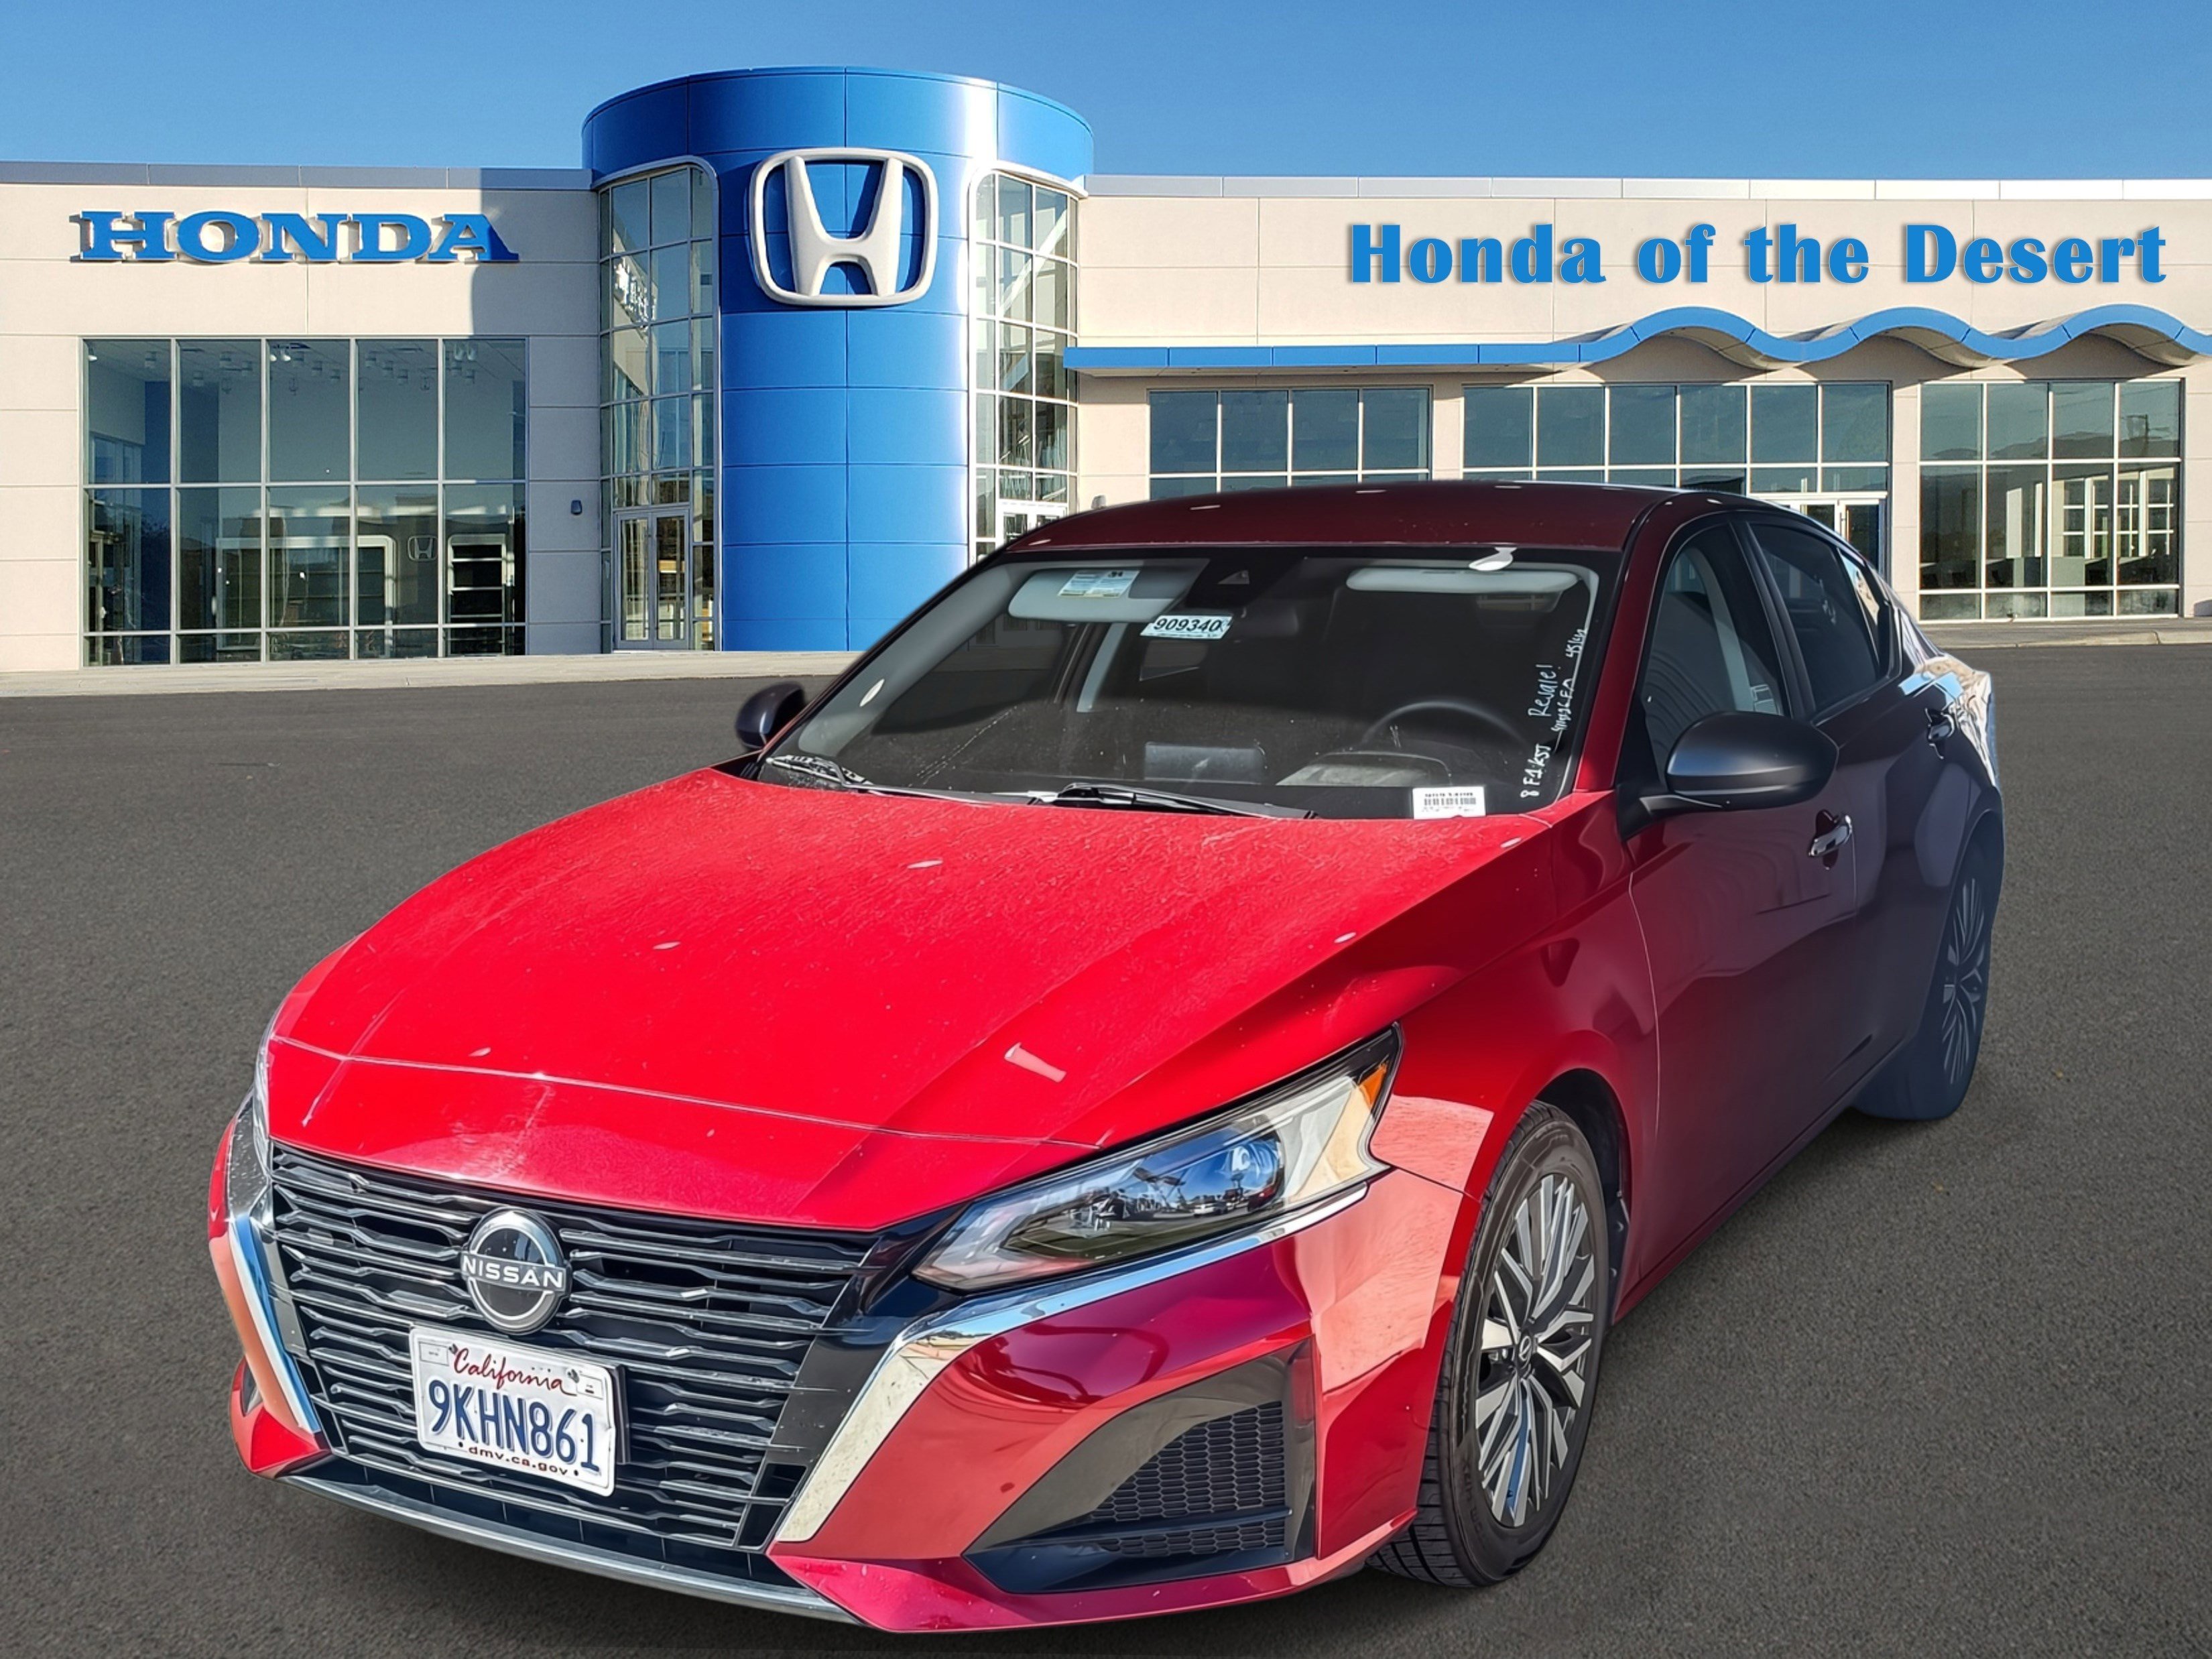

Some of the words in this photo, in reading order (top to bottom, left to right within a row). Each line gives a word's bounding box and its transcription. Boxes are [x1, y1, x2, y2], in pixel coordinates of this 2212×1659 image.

[78, 210, 519, 262] HONDA
[1351, 223, 1607, 284] Honda
[1638, 223, 1717, 284] of
[1743, 223, 1869, 284] the
[1906, 224, 2166, 284] Desert
[1153, 617, 1223, 633] 909340
[461, 1255, 564, 1289] NISSAN
[453, 1347, 578, 1396] California
[428, 1379, 601, 1473] 9KHN861
[468, 1445, 570, 1477] dmv.ca.gov
